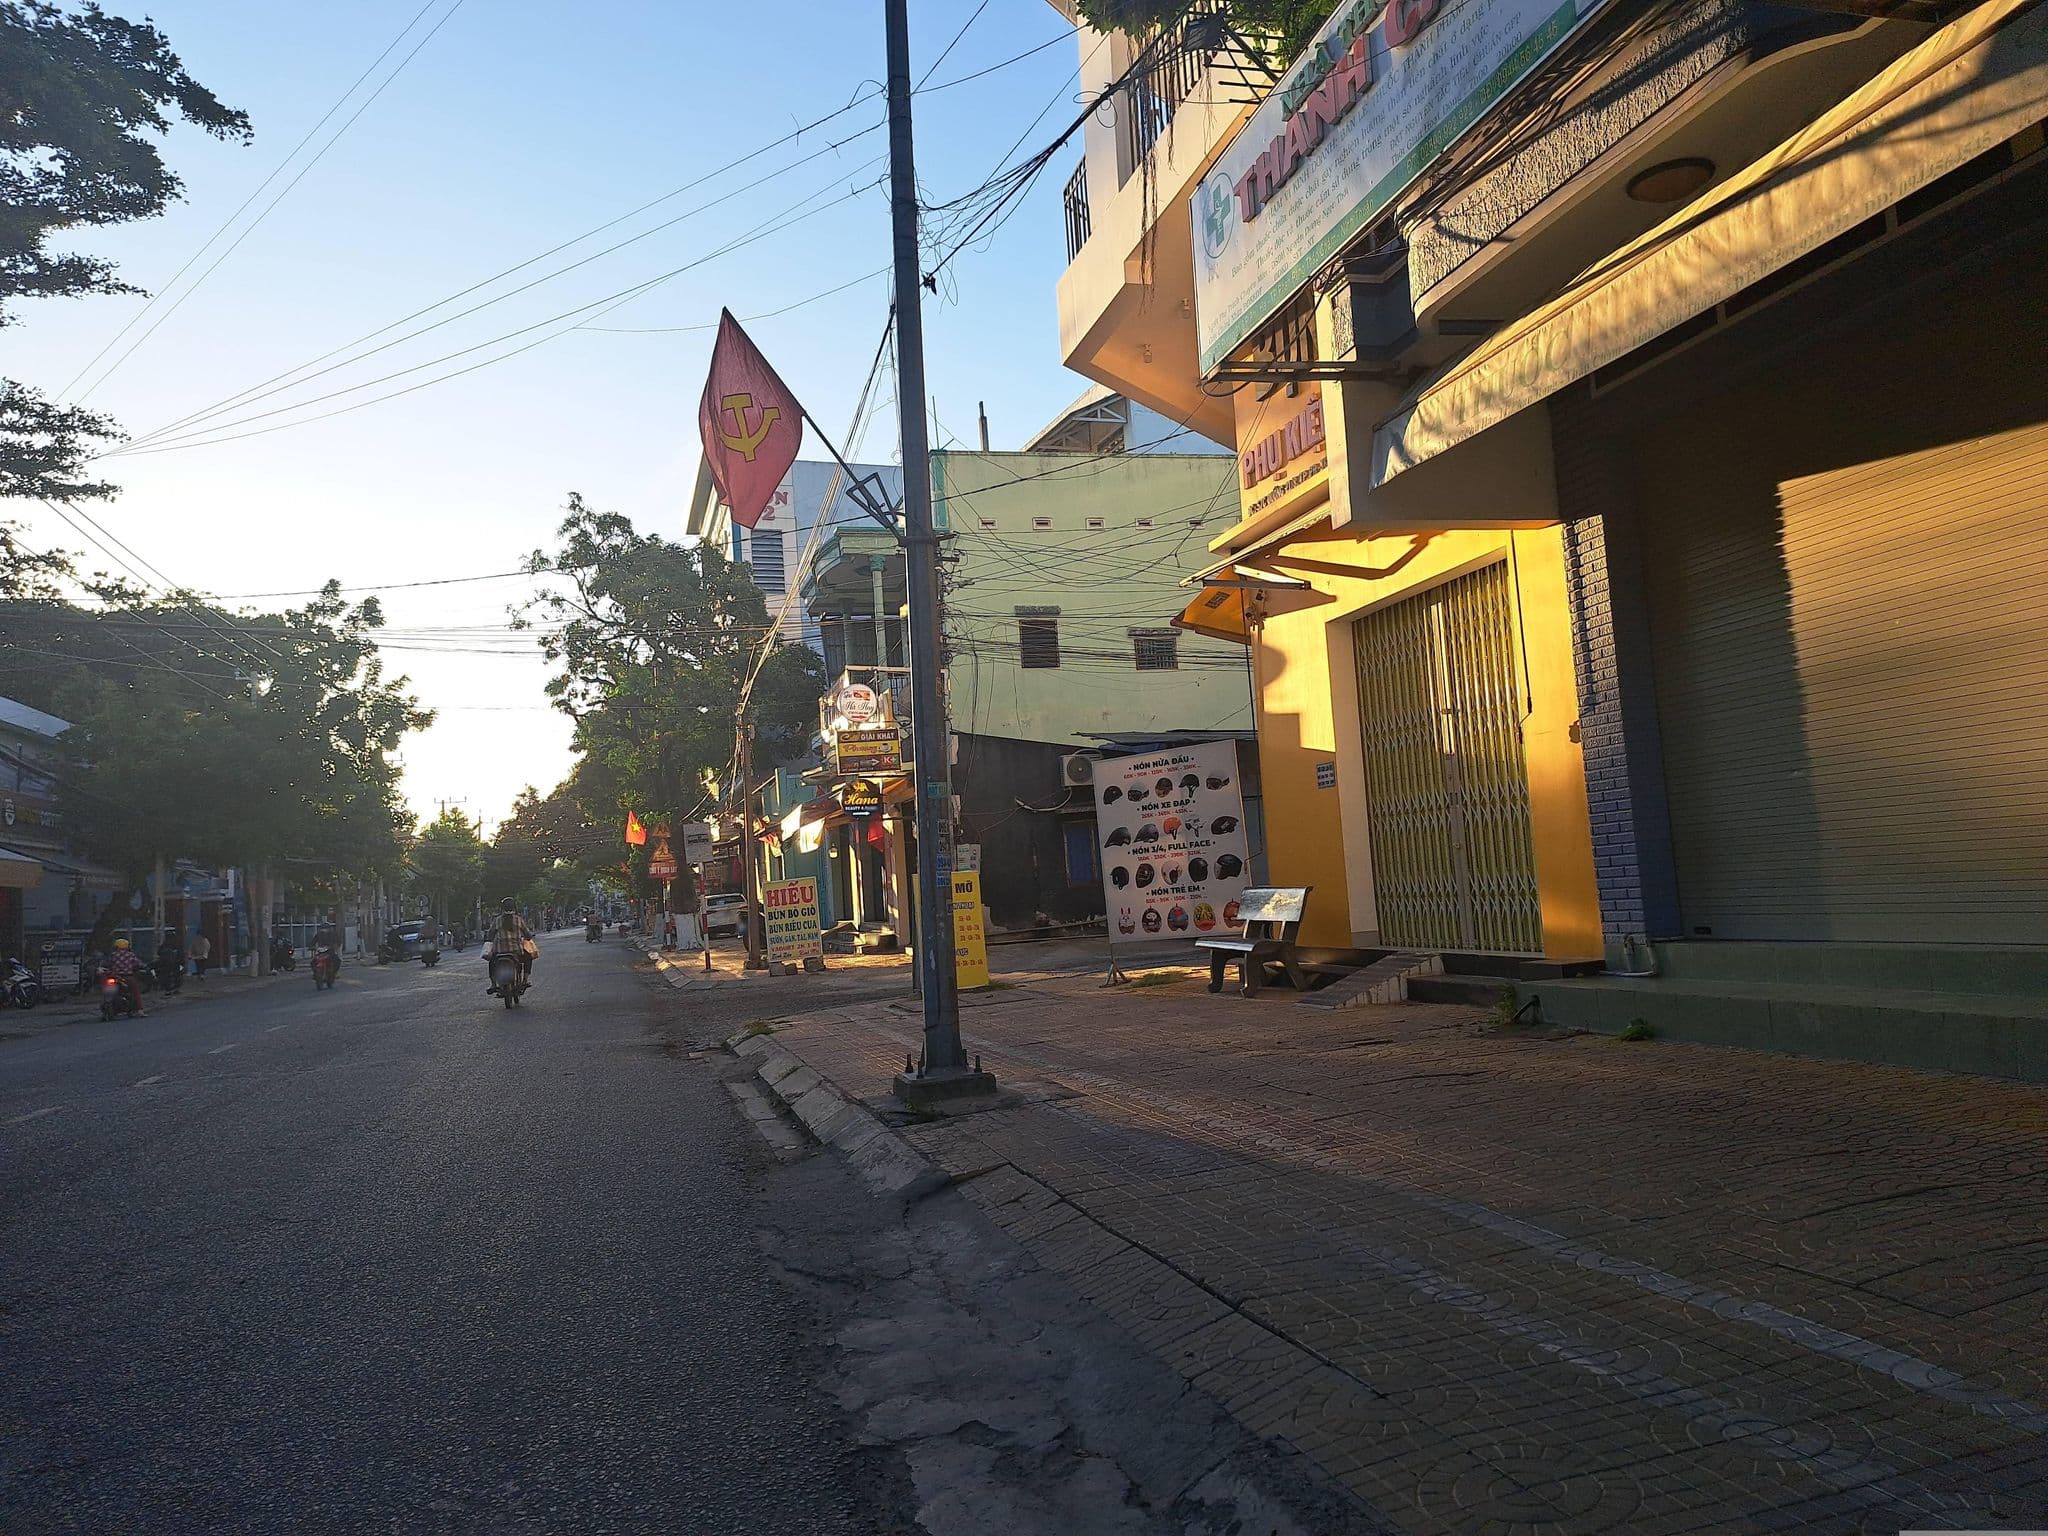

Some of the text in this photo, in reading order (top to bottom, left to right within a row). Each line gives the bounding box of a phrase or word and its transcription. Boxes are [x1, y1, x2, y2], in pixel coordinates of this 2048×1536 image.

[1234, 0, 1442, 223] THANH C
[1243, 428, 1287, 490] PHỤ
[1133, 761, 1151, 771] NÓN
[844, 793, 878, 806] Hana
[1141, 798, 1191, 812] NÓN XE ĐẠP
[1132, 839, 1211, 855] NÓN 3/4, FULL FACE
[1151, 886, 1169, 896] NÓN
[1187, 884, 1200, 892] EM
[768, 908, 786, 921] BÚN
[788, 906, 799, 918] BÒ
[769, 921, 784, 934] BÚN
[802, 920, 817, 930] CUA
